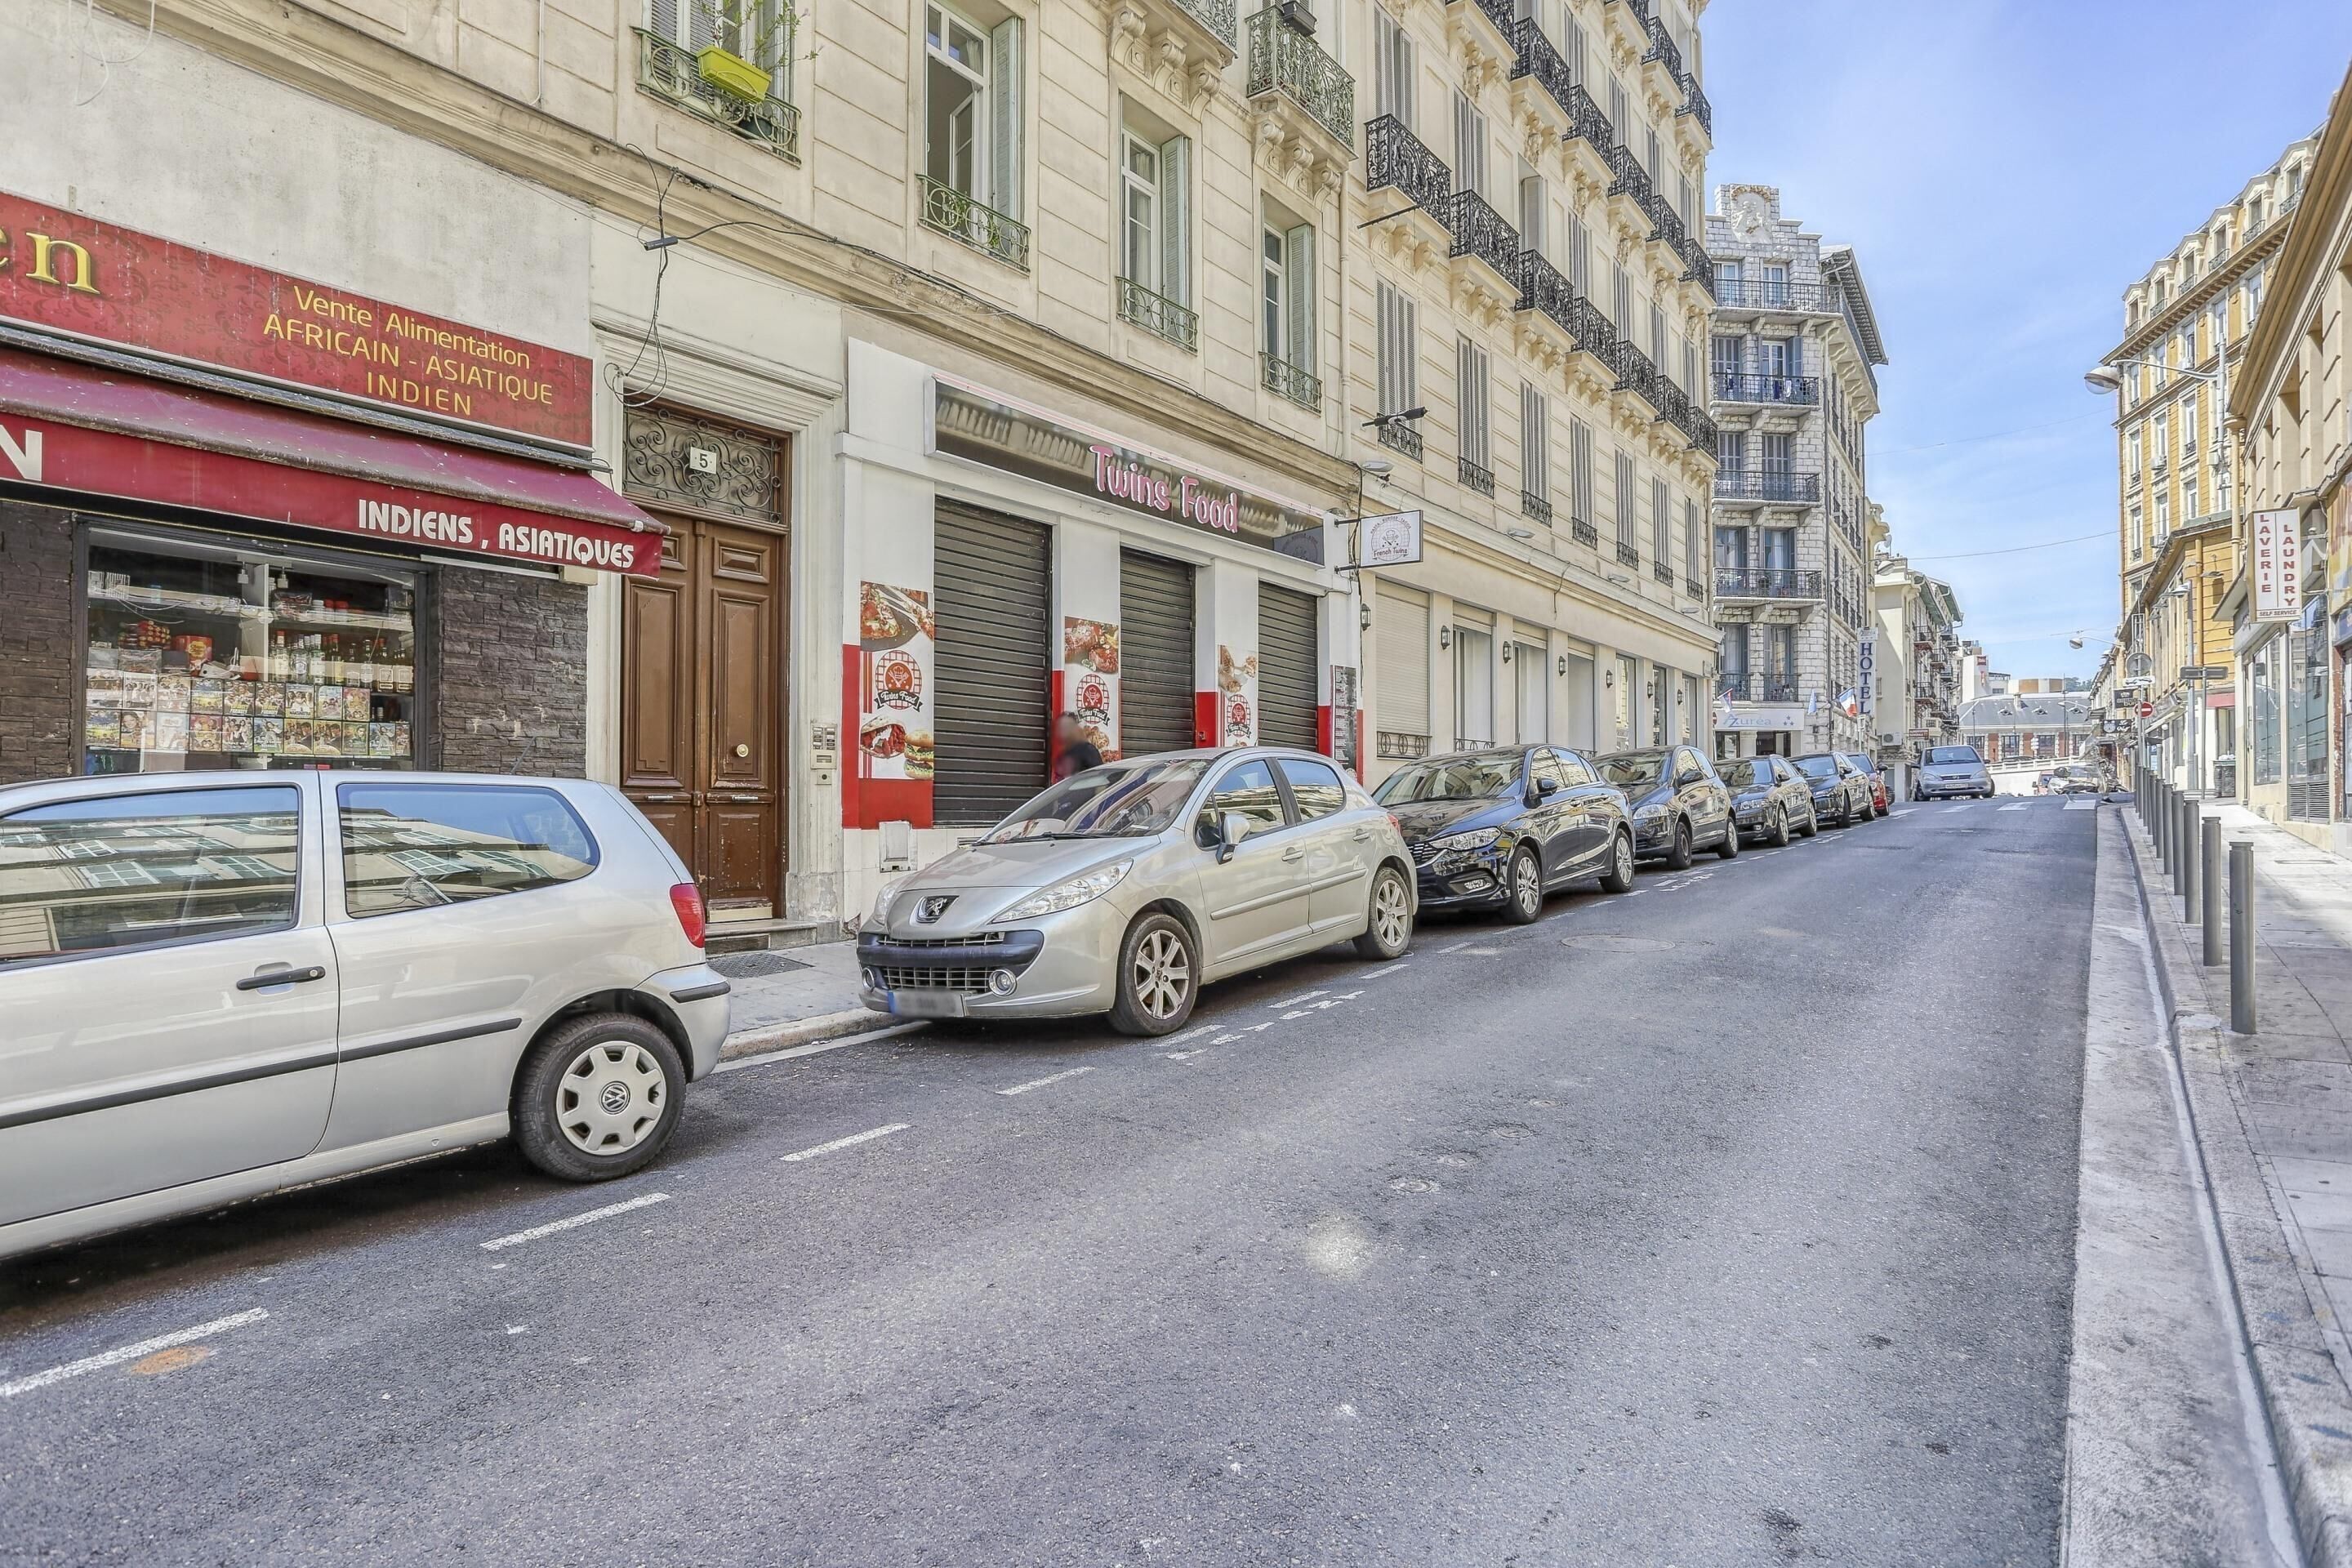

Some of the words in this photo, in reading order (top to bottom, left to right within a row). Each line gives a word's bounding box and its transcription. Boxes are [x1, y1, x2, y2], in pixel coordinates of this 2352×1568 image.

[0, 227, 100, 295] n
[263, 314, 400, 368] AFRICAIN
[425, 355, 553, 405] ASIATIQUE
[293, 285, 372, 327] Vente
[385, 313, 530, 369] Alimentation
[368, 372, 471, 416] INDIEN
[699, 452, 708, 469] 5
[1089, 445, 1170, 511] Twins
[1181, 475, 1238, 533] Food
[499, 523, 635, 568] ASIATIQUES
[1373, 548, 1392, 557] French
[2259, 514, 2272, 593] LAVERIE
[2283, 524, 2296, 607] LAUNDRY
[899, 690, 917, 704] Food
[1860, 642, 1873, 715] HOTEL
